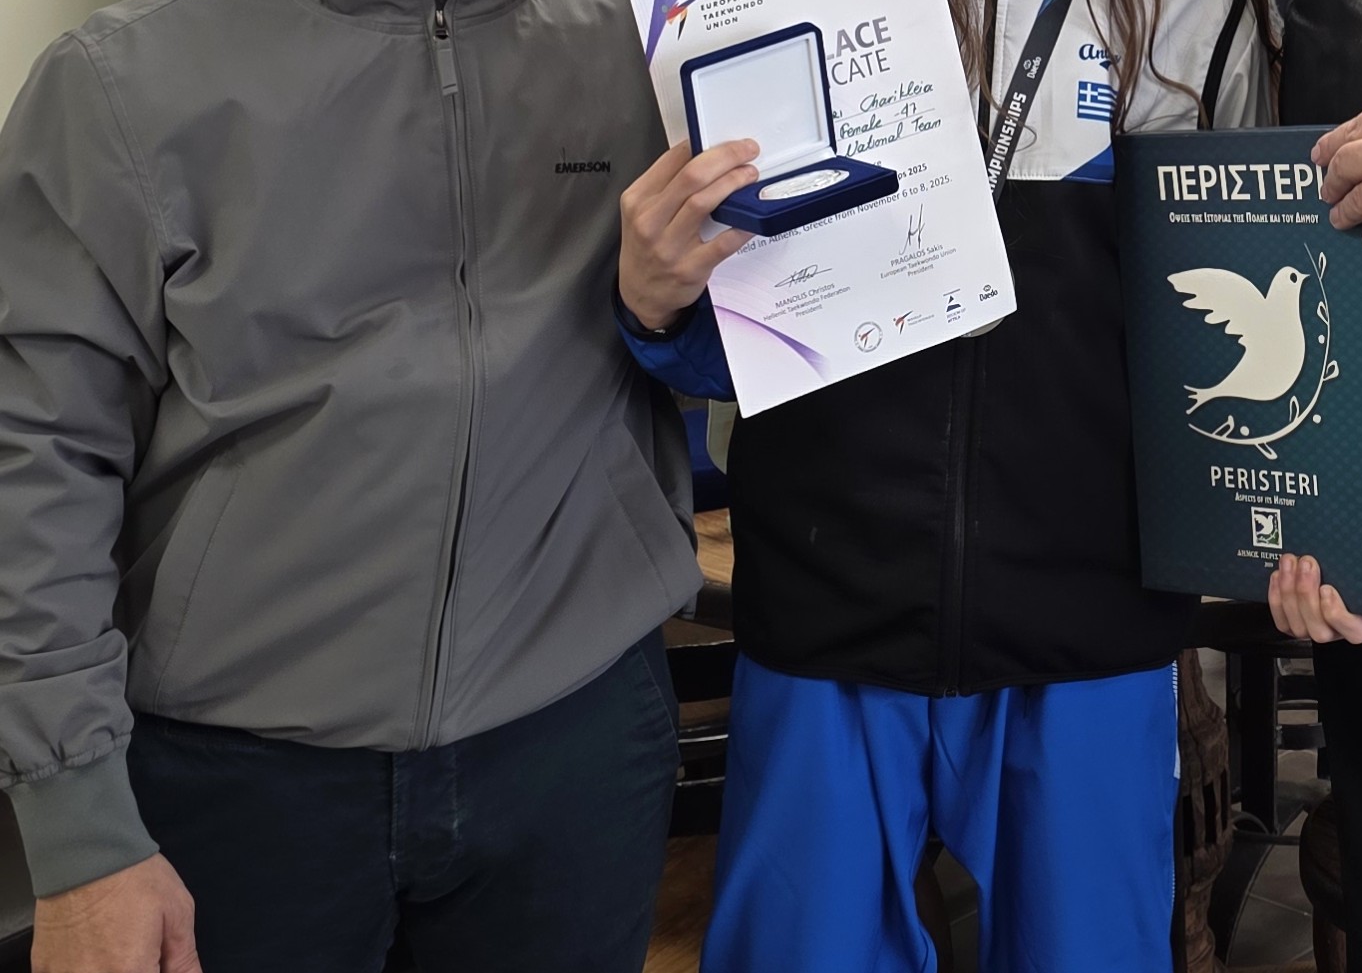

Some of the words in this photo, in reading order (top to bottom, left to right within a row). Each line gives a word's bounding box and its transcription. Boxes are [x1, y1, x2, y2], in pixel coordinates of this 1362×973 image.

[706, 16, 739, 31] UNION
[827, 16, 892, 60] ACE
[911, 116, 942, 133] Team
[555, 160, 611, 174] EMERSON
[908, 163, 928, 176] 2025
[902, 189, 908, 198] 6
[909, 187, 918, 196] to
[890, 249, 926, 267] PRAGALOS
[1210, 465, 1319, 496] PERISTERI
